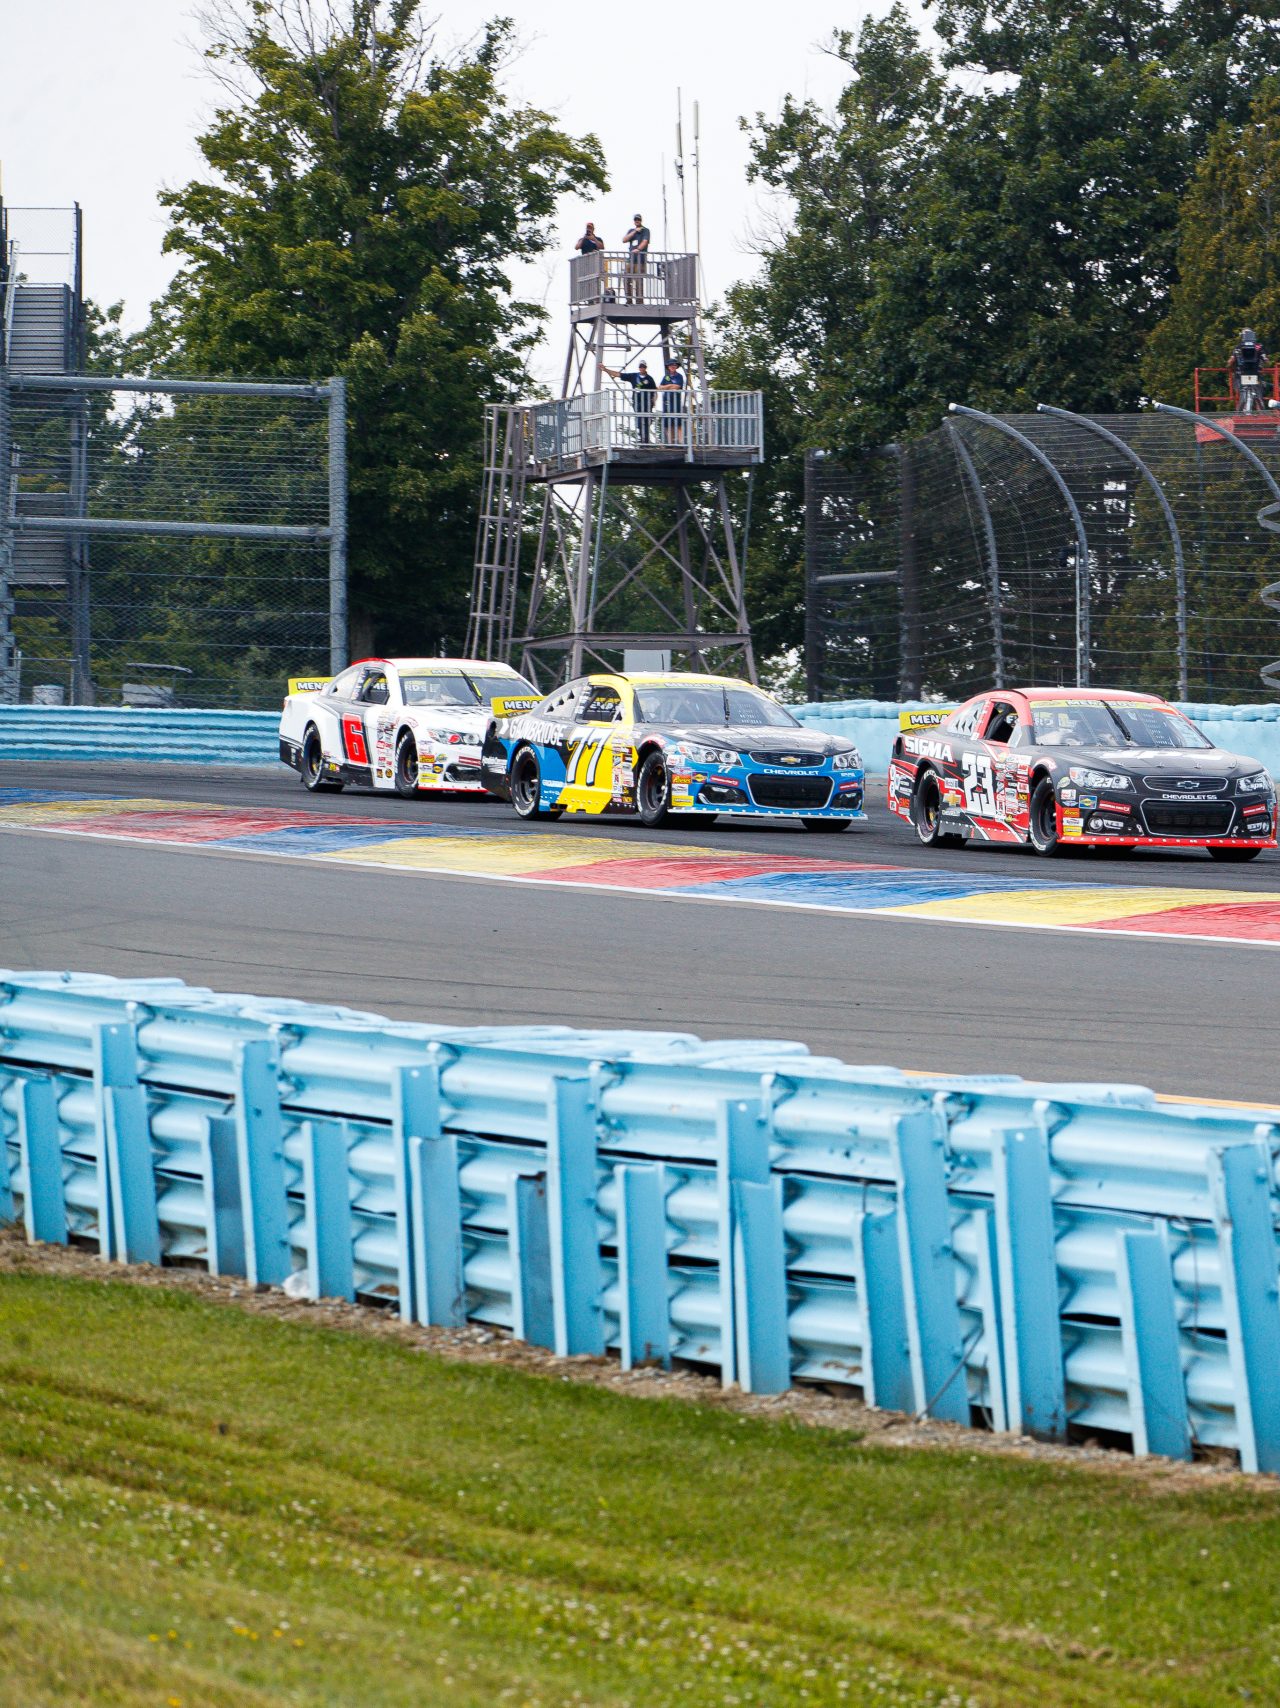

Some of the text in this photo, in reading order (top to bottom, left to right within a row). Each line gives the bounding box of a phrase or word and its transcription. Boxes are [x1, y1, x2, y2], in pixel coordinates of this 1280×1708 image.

[342, 711, 369, 766] 6
[509, 719, 567, 747] GAINBRIDGE
[566, 727, 615, 787] 77
[904, 735, 954, 763] SIGMA
[718, 764, 733, 774] 77
[763, 768, 820, 776] CHEVROLET
[1093, 777, 1112, 788] 23
[961, 750, 998, 818] 23
